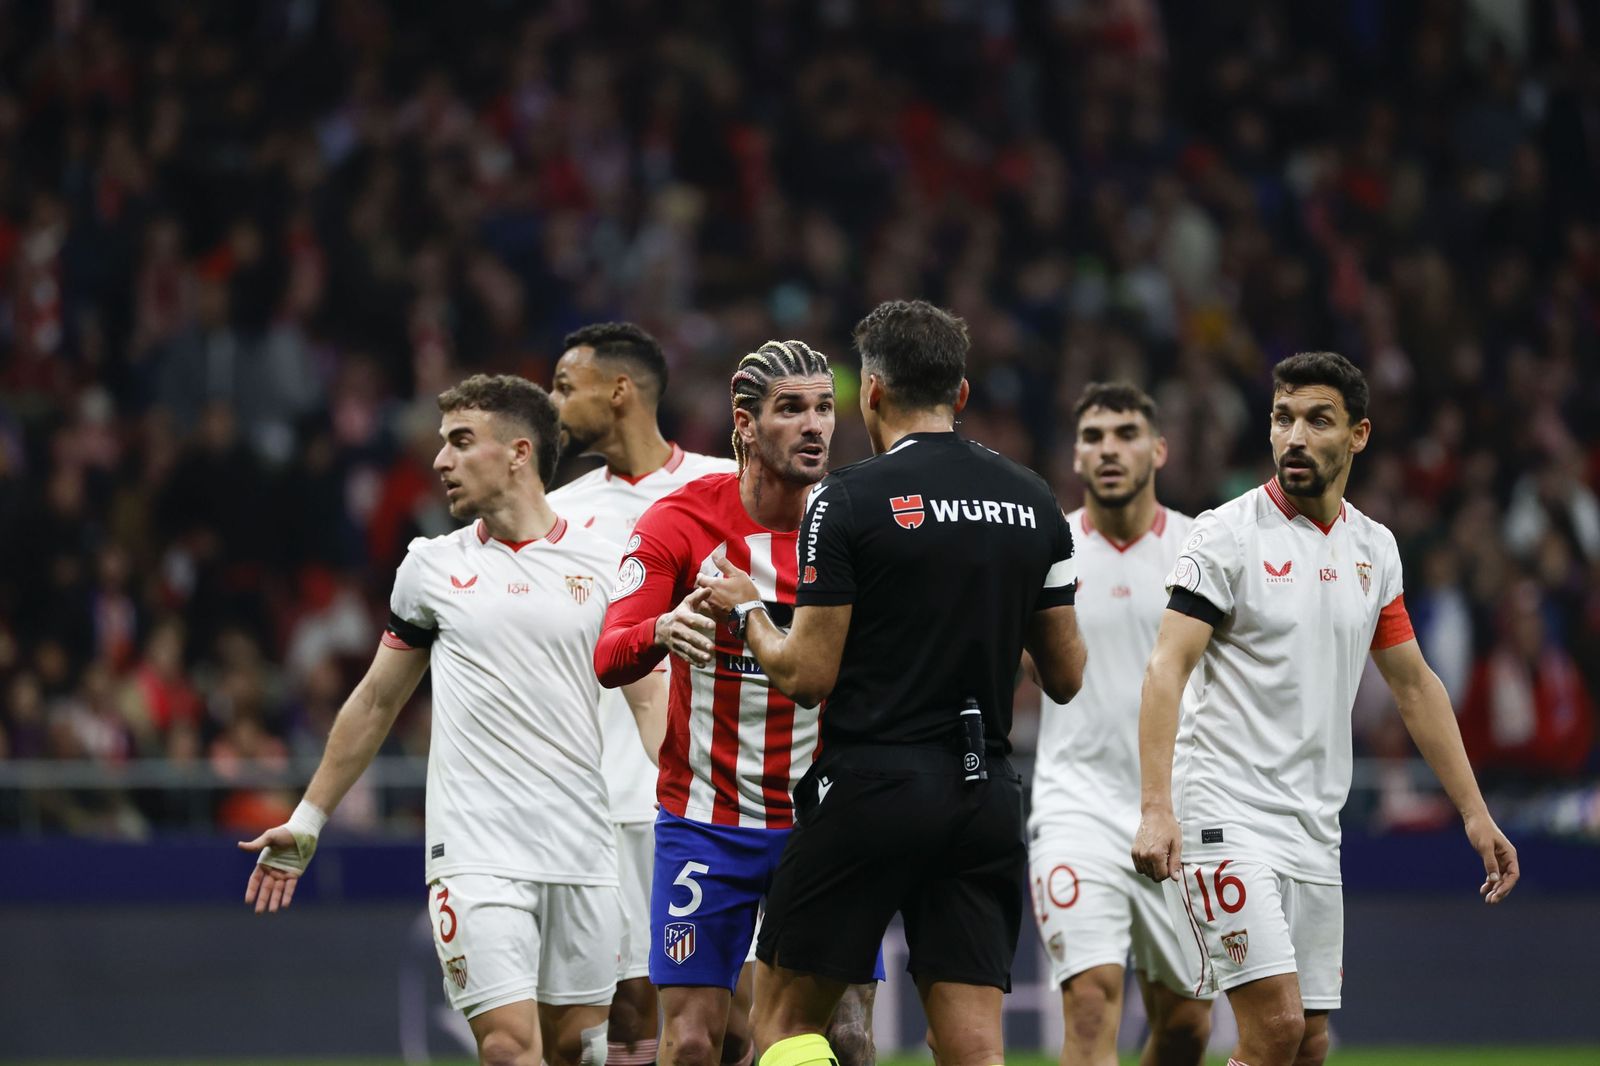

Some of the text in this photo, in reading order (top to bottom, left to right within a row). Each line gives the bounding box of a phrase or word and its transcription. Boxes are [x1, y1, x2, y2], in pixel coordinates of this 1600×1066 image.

[807, 501, 829, 562] WÜRTH
[930, 499, 1036, 529] WÜRTH
[1319, 568, 1338, 582] 134
[729, 655, 761, 672] RIY
[436, 888, 458, 944] 3
[668, 861, 710, 917] 5
[1194, 860, 1247, 922] 16
